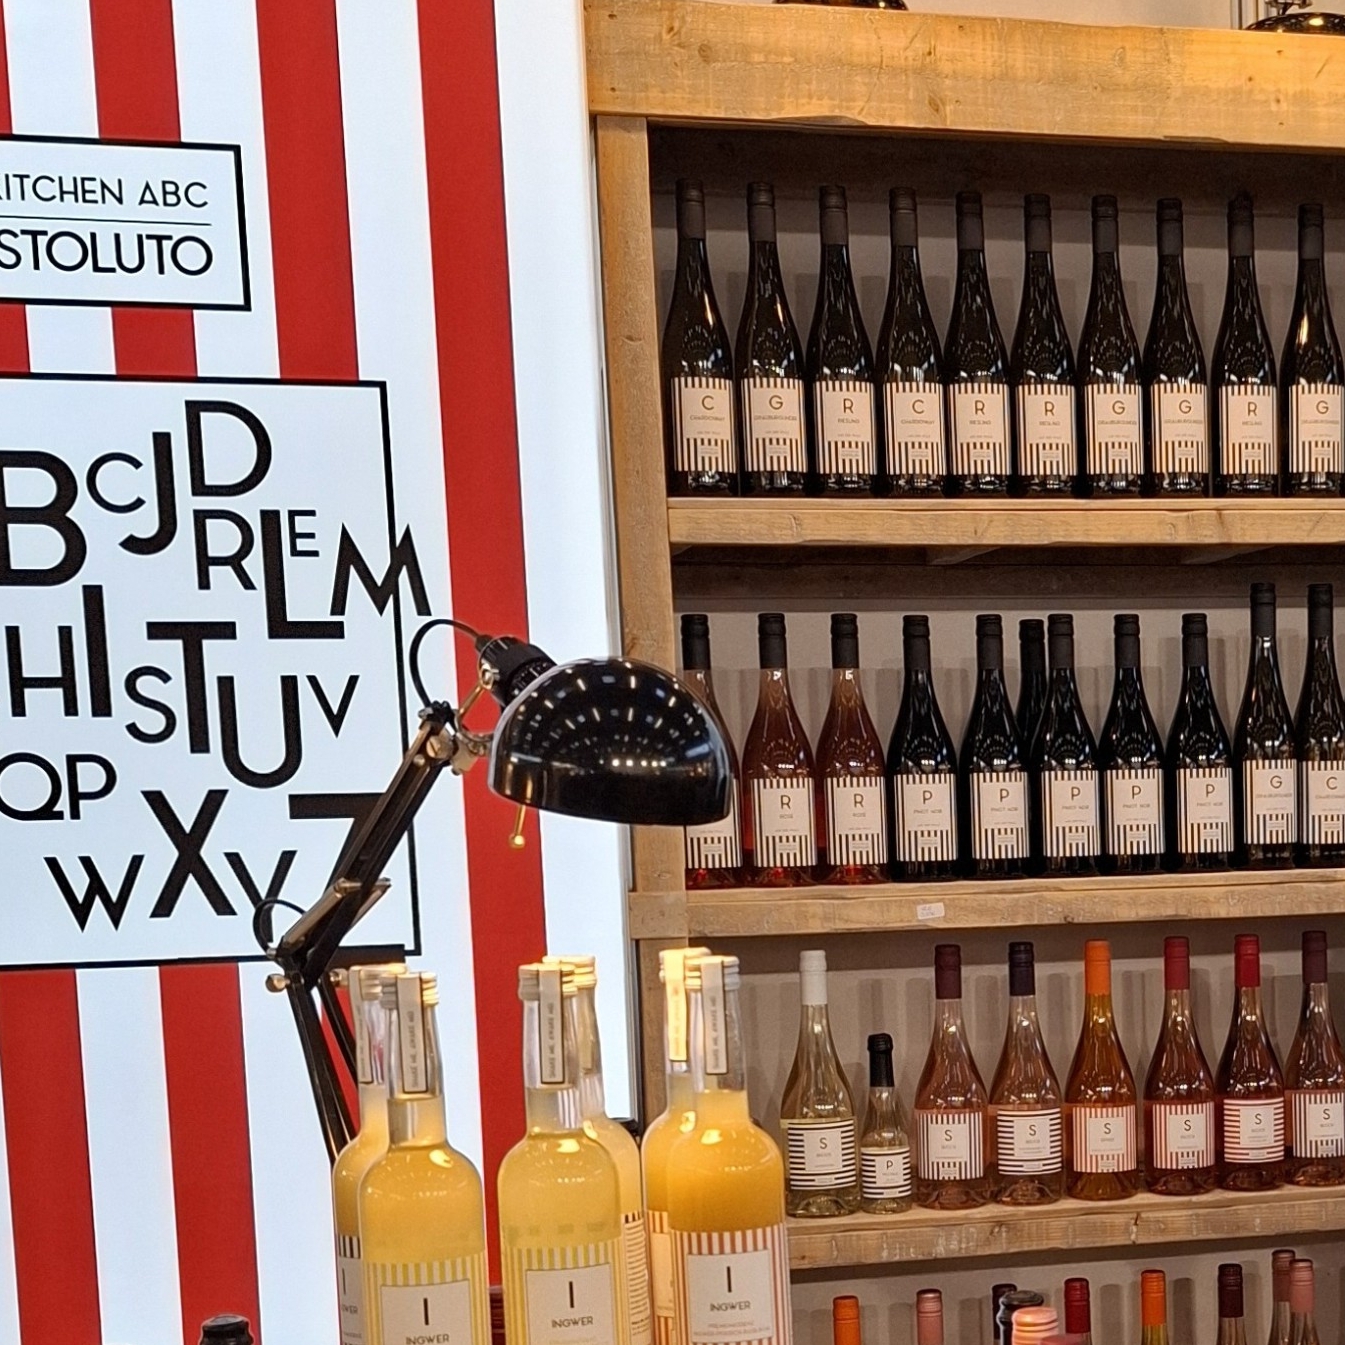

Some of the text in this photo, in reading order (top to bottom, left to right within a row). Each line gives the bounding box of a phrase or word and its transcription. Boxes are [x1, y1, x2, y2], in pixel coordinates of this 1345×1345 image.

[0, 174, 208, 208] ITCHEN ABC
[702, 395, 714, 410] C
[769, 395, 783, 410] G
[843, 399, 853, 413] R
[912, 400, 924, 414] C
[975, 400, 985, 415] R
[1045, 401, 1054, 416] R
[1112, 401, 1125, 414] G
[1179, 400, 1191, 414] G
[1248, 402, 1257, 416] R
[1316, 401, 1329, 414] G
[119, 432, 178, 555] J
[184, 400, 272, 497] D
[193, 509, 432, 639] R L E M
[4, 625, 79, 717] H
[146, 621, 236, 753] T
[125, 666, 177, 744] S
[306, 675, 360, 737] V
[217, 676, 302, 788] U
[66, 754, 117, 820] P
[1270, 775, 1282, 789] G
[1326, 777, 1338, 790] C
[923, 790, 932, 804] P
[1000, 789, 1009, 802] P
[1071, 787, 1080, 800] P
[1132, 785, 1141, 799] P
[1206, 784, 1215, 797] P
[780, 795, 791, 809] R
[854, 794, 864, 807] R
[43, 855, 145, 933] W
[140, 789, 238, 918] X
[1254, 1114, 1262, 1124] S
[1323, 1109, 1330, 1120] S
[1029, 1125, 1037, 1136] S
[1104, 1123, 1111, 1134] S
[1184, 1120, 1191, 1131] S
[944, 1130, 952, 1141] S
[820, 1138, 827, 1149] S
[887, 1160, 893, 1170] P
[727, 1266, 732, 1292] I
[569, 1281, 574, 1308] I
[423, 1298, 429, 1325] I
[710, 1301, 751, 1312] INGWER
[552, 1316, 593, 1328] INGWER
[406, 1334, 449, 1345] INGWER
